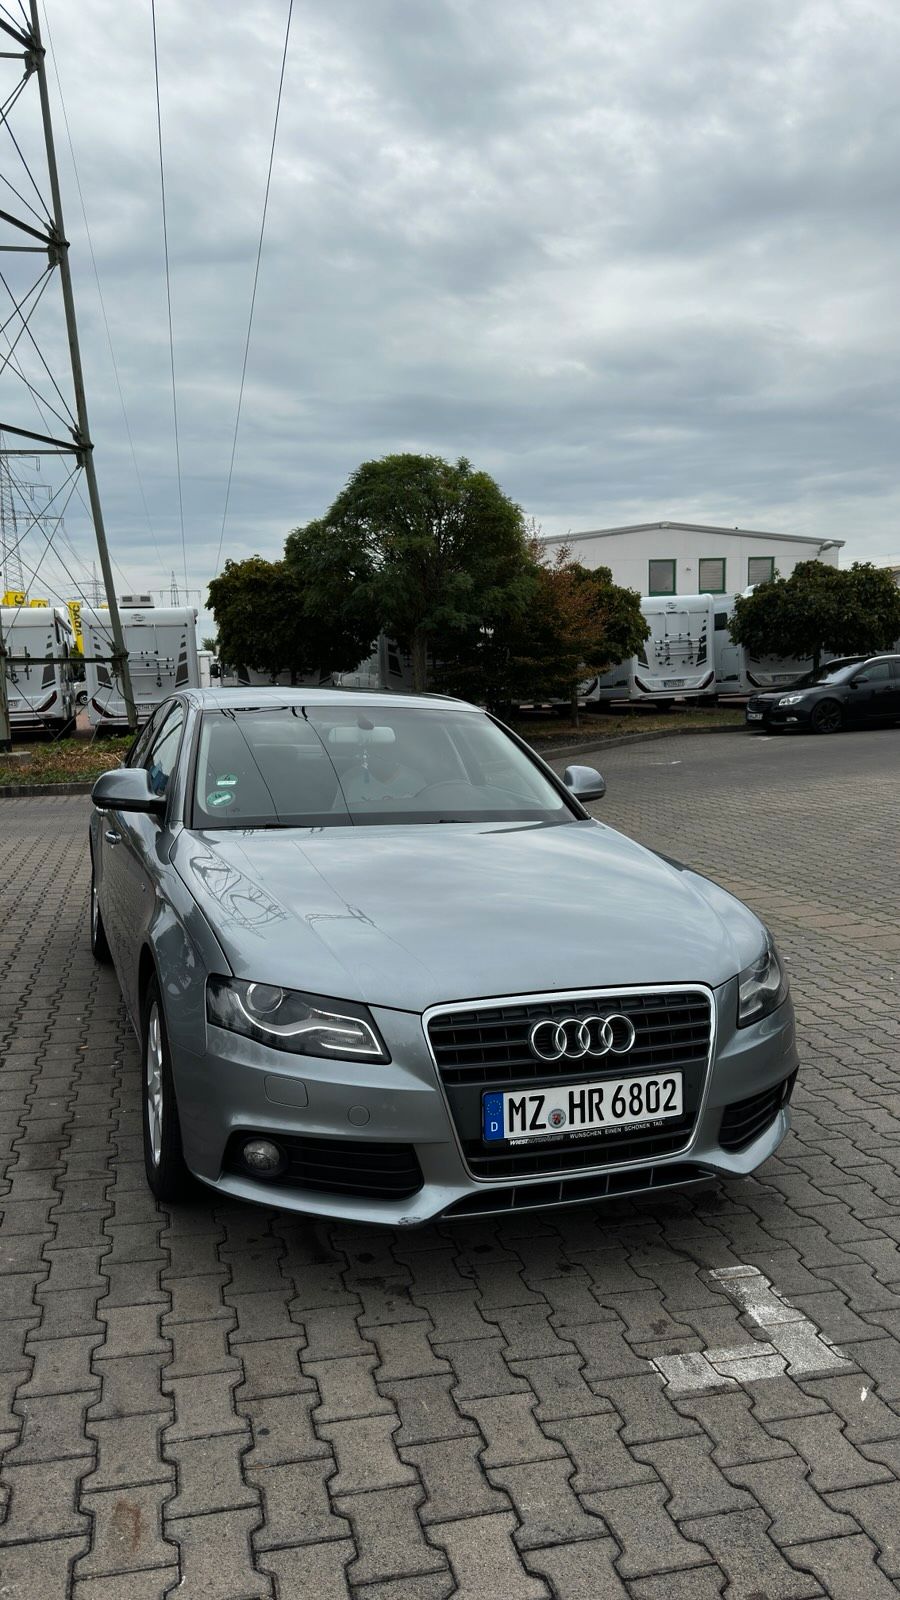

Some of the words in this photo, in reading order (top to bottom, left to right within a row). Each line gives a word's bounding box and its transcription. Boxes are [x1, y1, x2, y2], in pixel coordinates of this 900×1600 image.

[490, 1121, 498, 1132] D
[508, 1094, 547, 1133] MZ
[568, 1087, 605, 1125] HR
[611, 1078, 677, 1119] 6802
